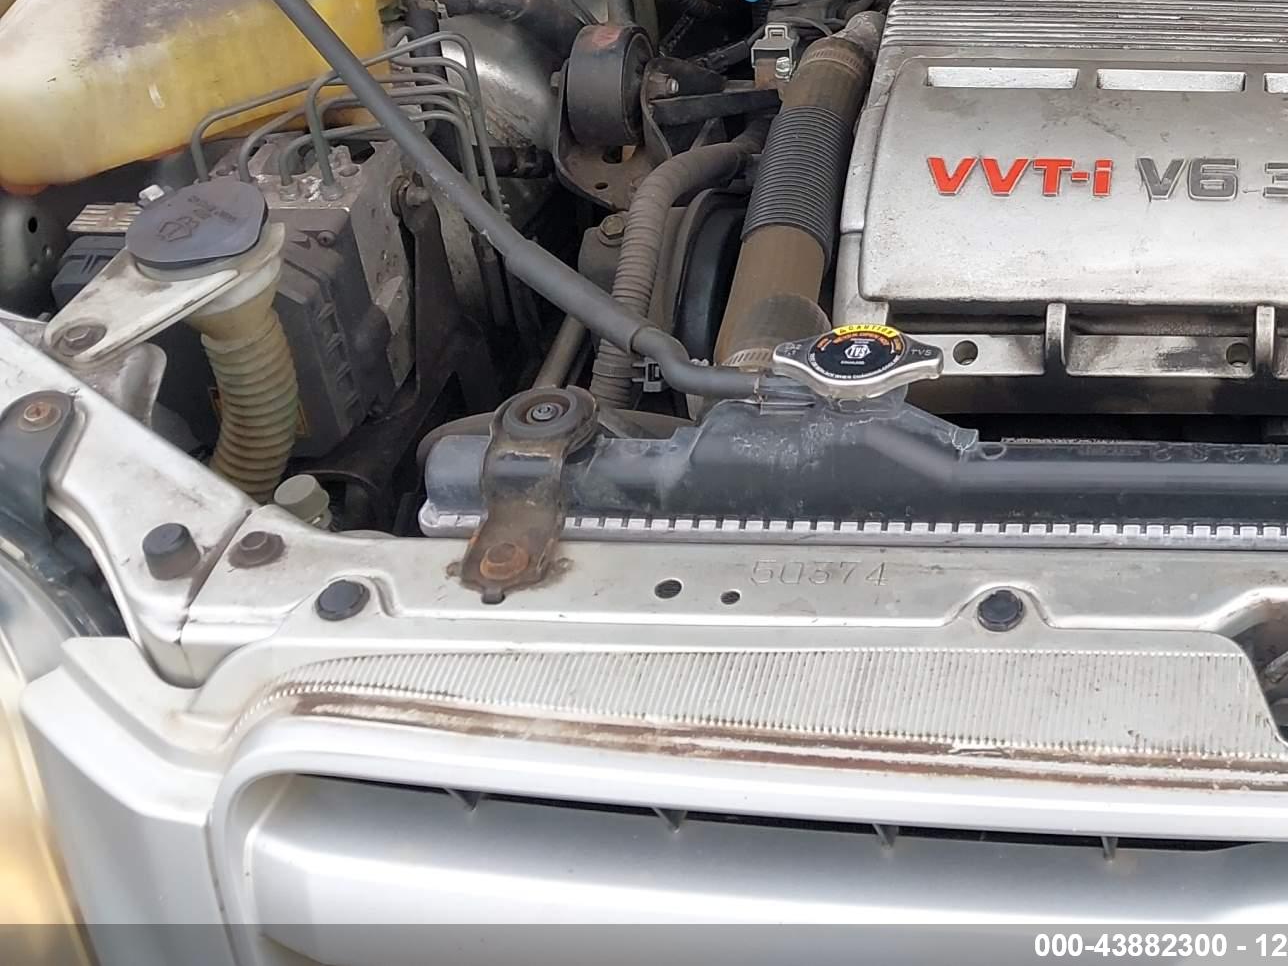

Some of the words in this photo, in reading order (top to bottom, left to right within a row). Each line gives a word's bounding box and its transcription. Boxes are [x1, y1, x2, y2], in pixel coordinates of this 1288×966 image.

[927, 157, 1115, 197] VVT-i
[1136, 157, 1240, 202] V6
[848, 324, 895, 335] CAUTION
[850, 346, 869, 357] TVS
